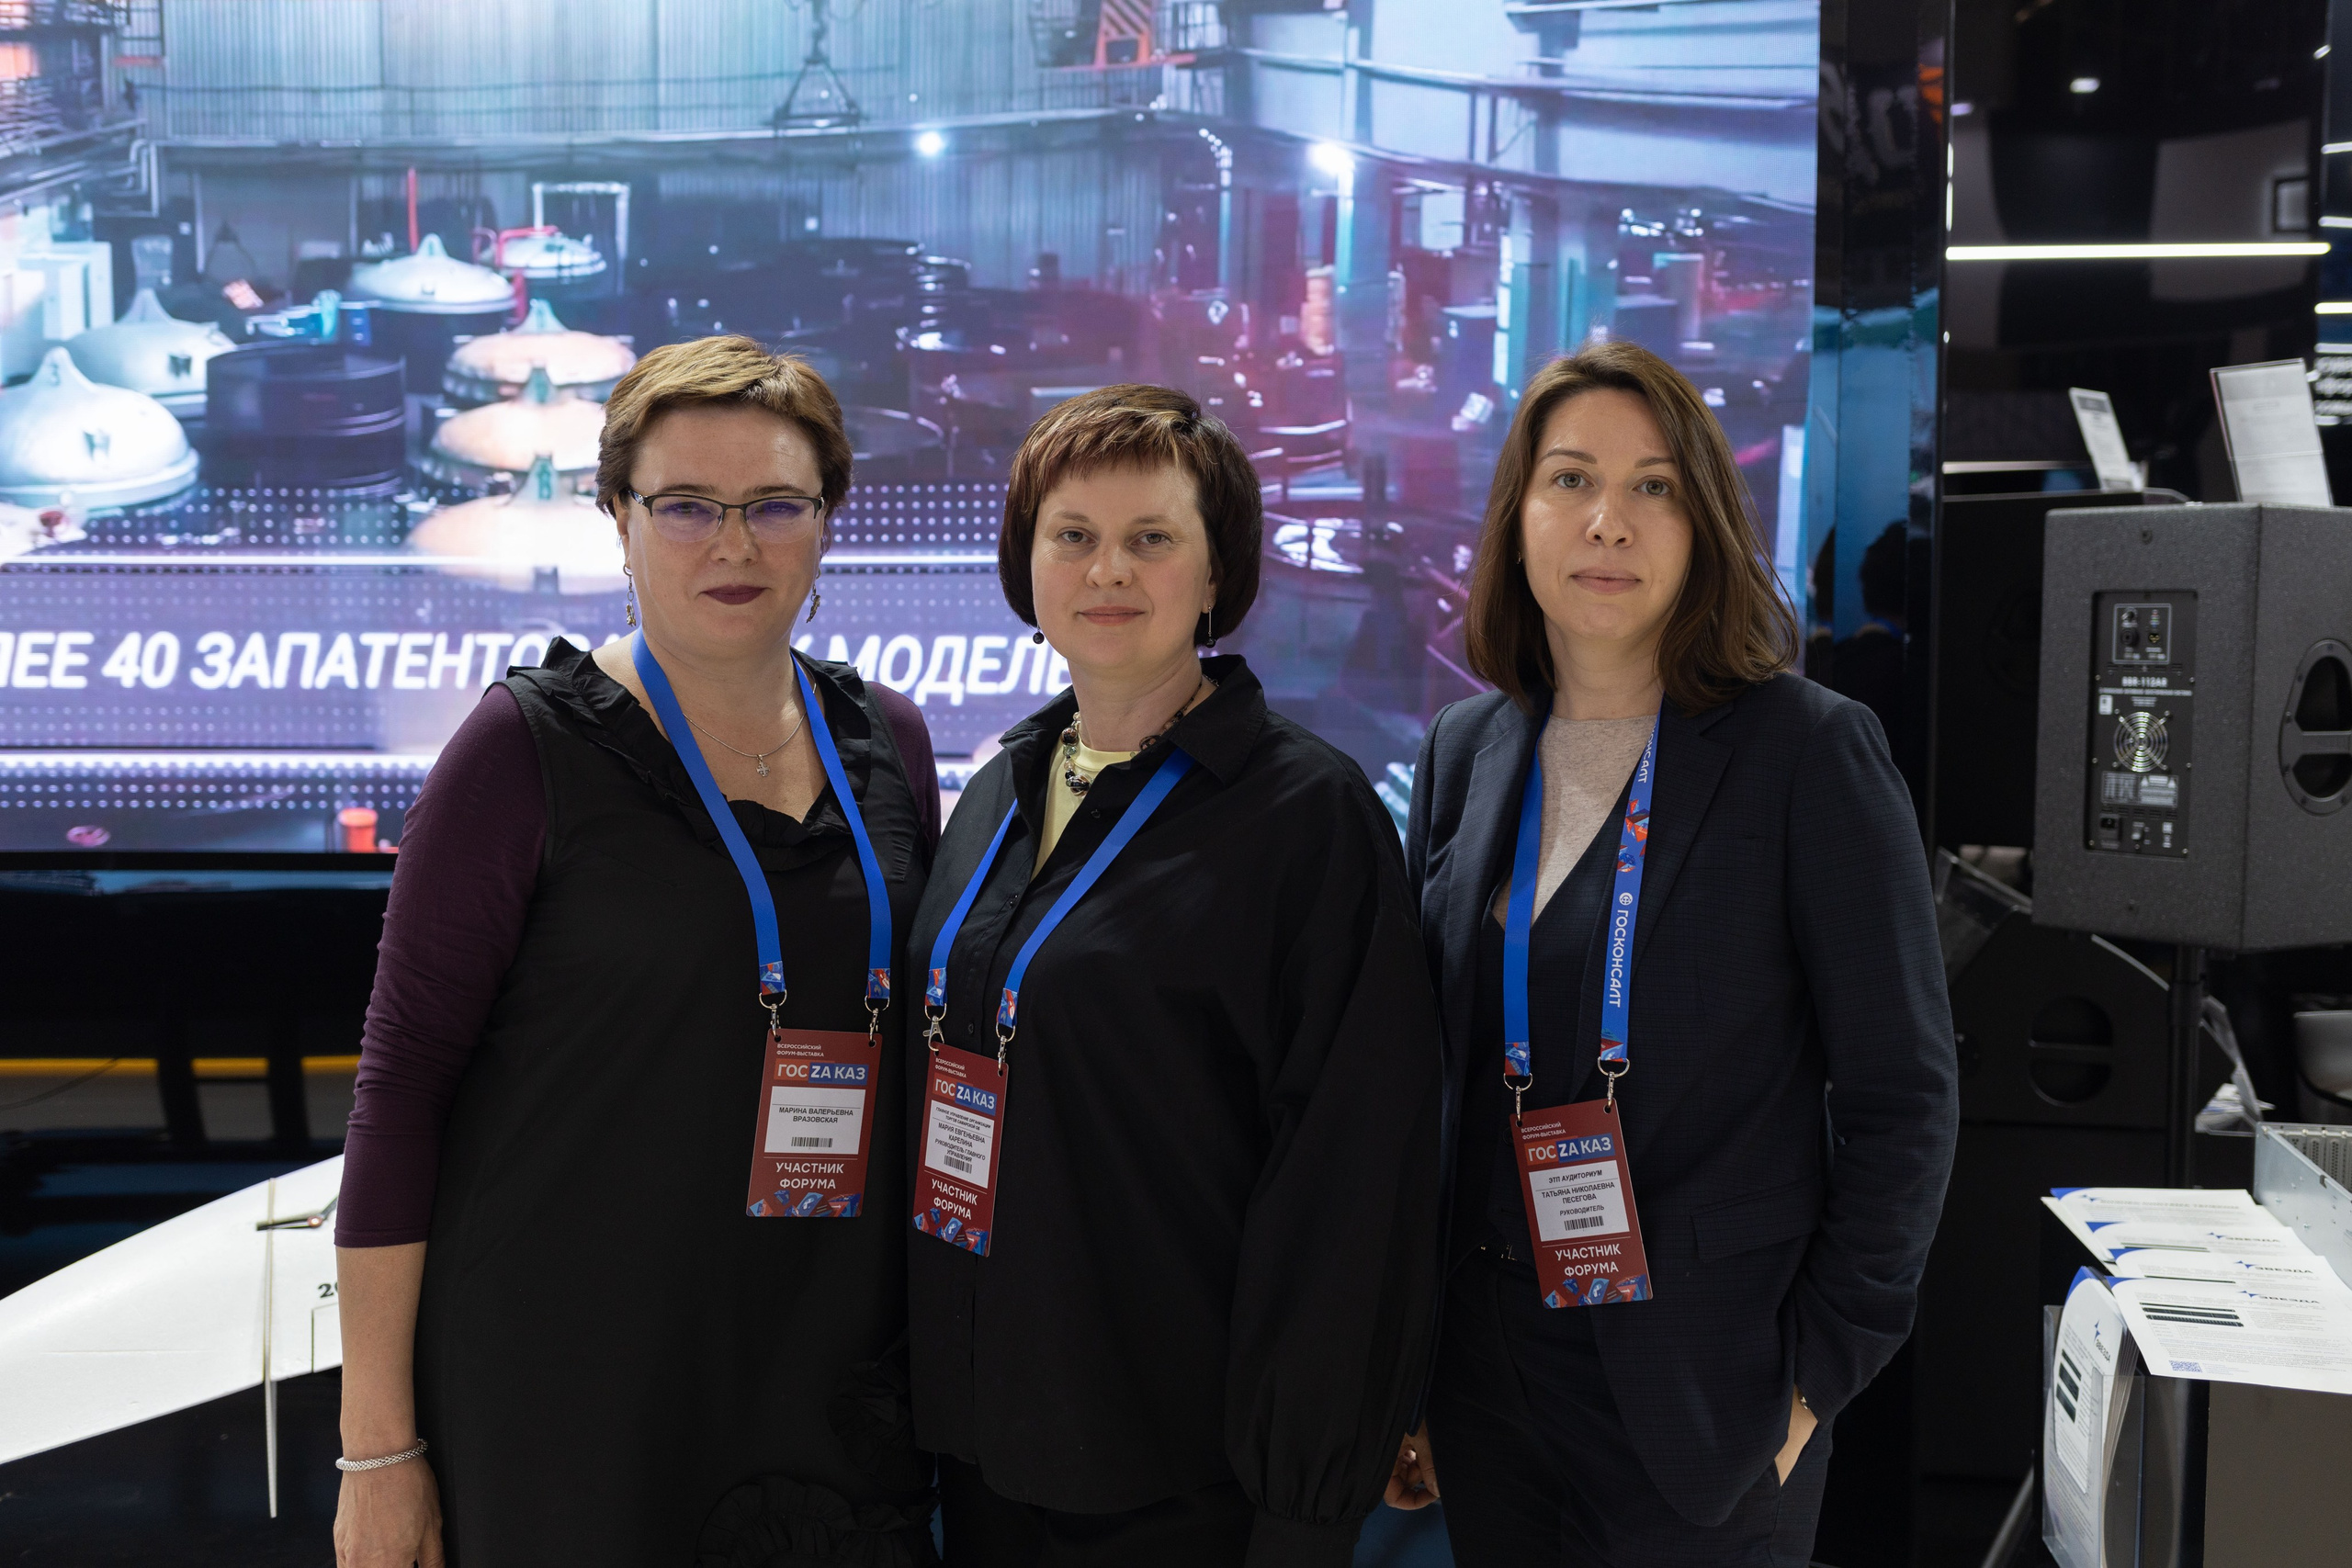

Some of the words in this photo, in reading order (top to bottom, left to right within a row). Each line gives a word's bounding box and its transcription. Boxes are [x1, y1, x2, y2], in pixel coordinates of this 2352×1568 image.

[101, 631, 180, 689] 40
[1609, 909, 1629, 1008] ГОСКОНСАЛТ
[935, 1057, 966, 1070] ВСЕРОССИЙСКИЙ
[808, 1108, 854, 1116] ВАЛЕРЬЕВНА
[793, 1115, 838, 1123] ВРАЗОВСКАЯ
[938, 1122, 955, 1133] МАРИЯ
[955, 1128, 986, 1144] ЕВГЕНЬЕВНА
[1521, 1122, 1562, 1134] ВСЕРОССИЙСКИЙ
[1522, 1129, 1566, 1140] ФОРУМ-ВЫСТАВКА
[948, 1134, 973, 1148] КАРЕЛИНА
[934, 1138, 965, 1154] РУКОВОДИТЕЛЬ
[964, 1148, 986, 1161] ГЛАВНОГО
[946, 1149, 973, 1162] УПРАВЛЕНИЯ
[775, 1162, 844, 1174] УЧАСТНИК
[1561, 1169, 1602, 1182] АУДИТОРИУМ
[779, 1178, 836, 1190] ФОРУМА
[1542, 1188, 1571, 1199] ТАТЬЯНА
[1571, 1181, 1615, 1194] НИКОЛАЕВНА
[932, 1179, 978, 1206] УЧАСТНИК
[933, 1197, 972, 1220] ФОРУМА
[1559, 1204, 1605, 1216] РУКОВОДИТЕЛЬ
[1555, 1243, 1622, 1261] УЧАСТНИК
[1564, 1261, 1619, 1278] ФОРУМА
